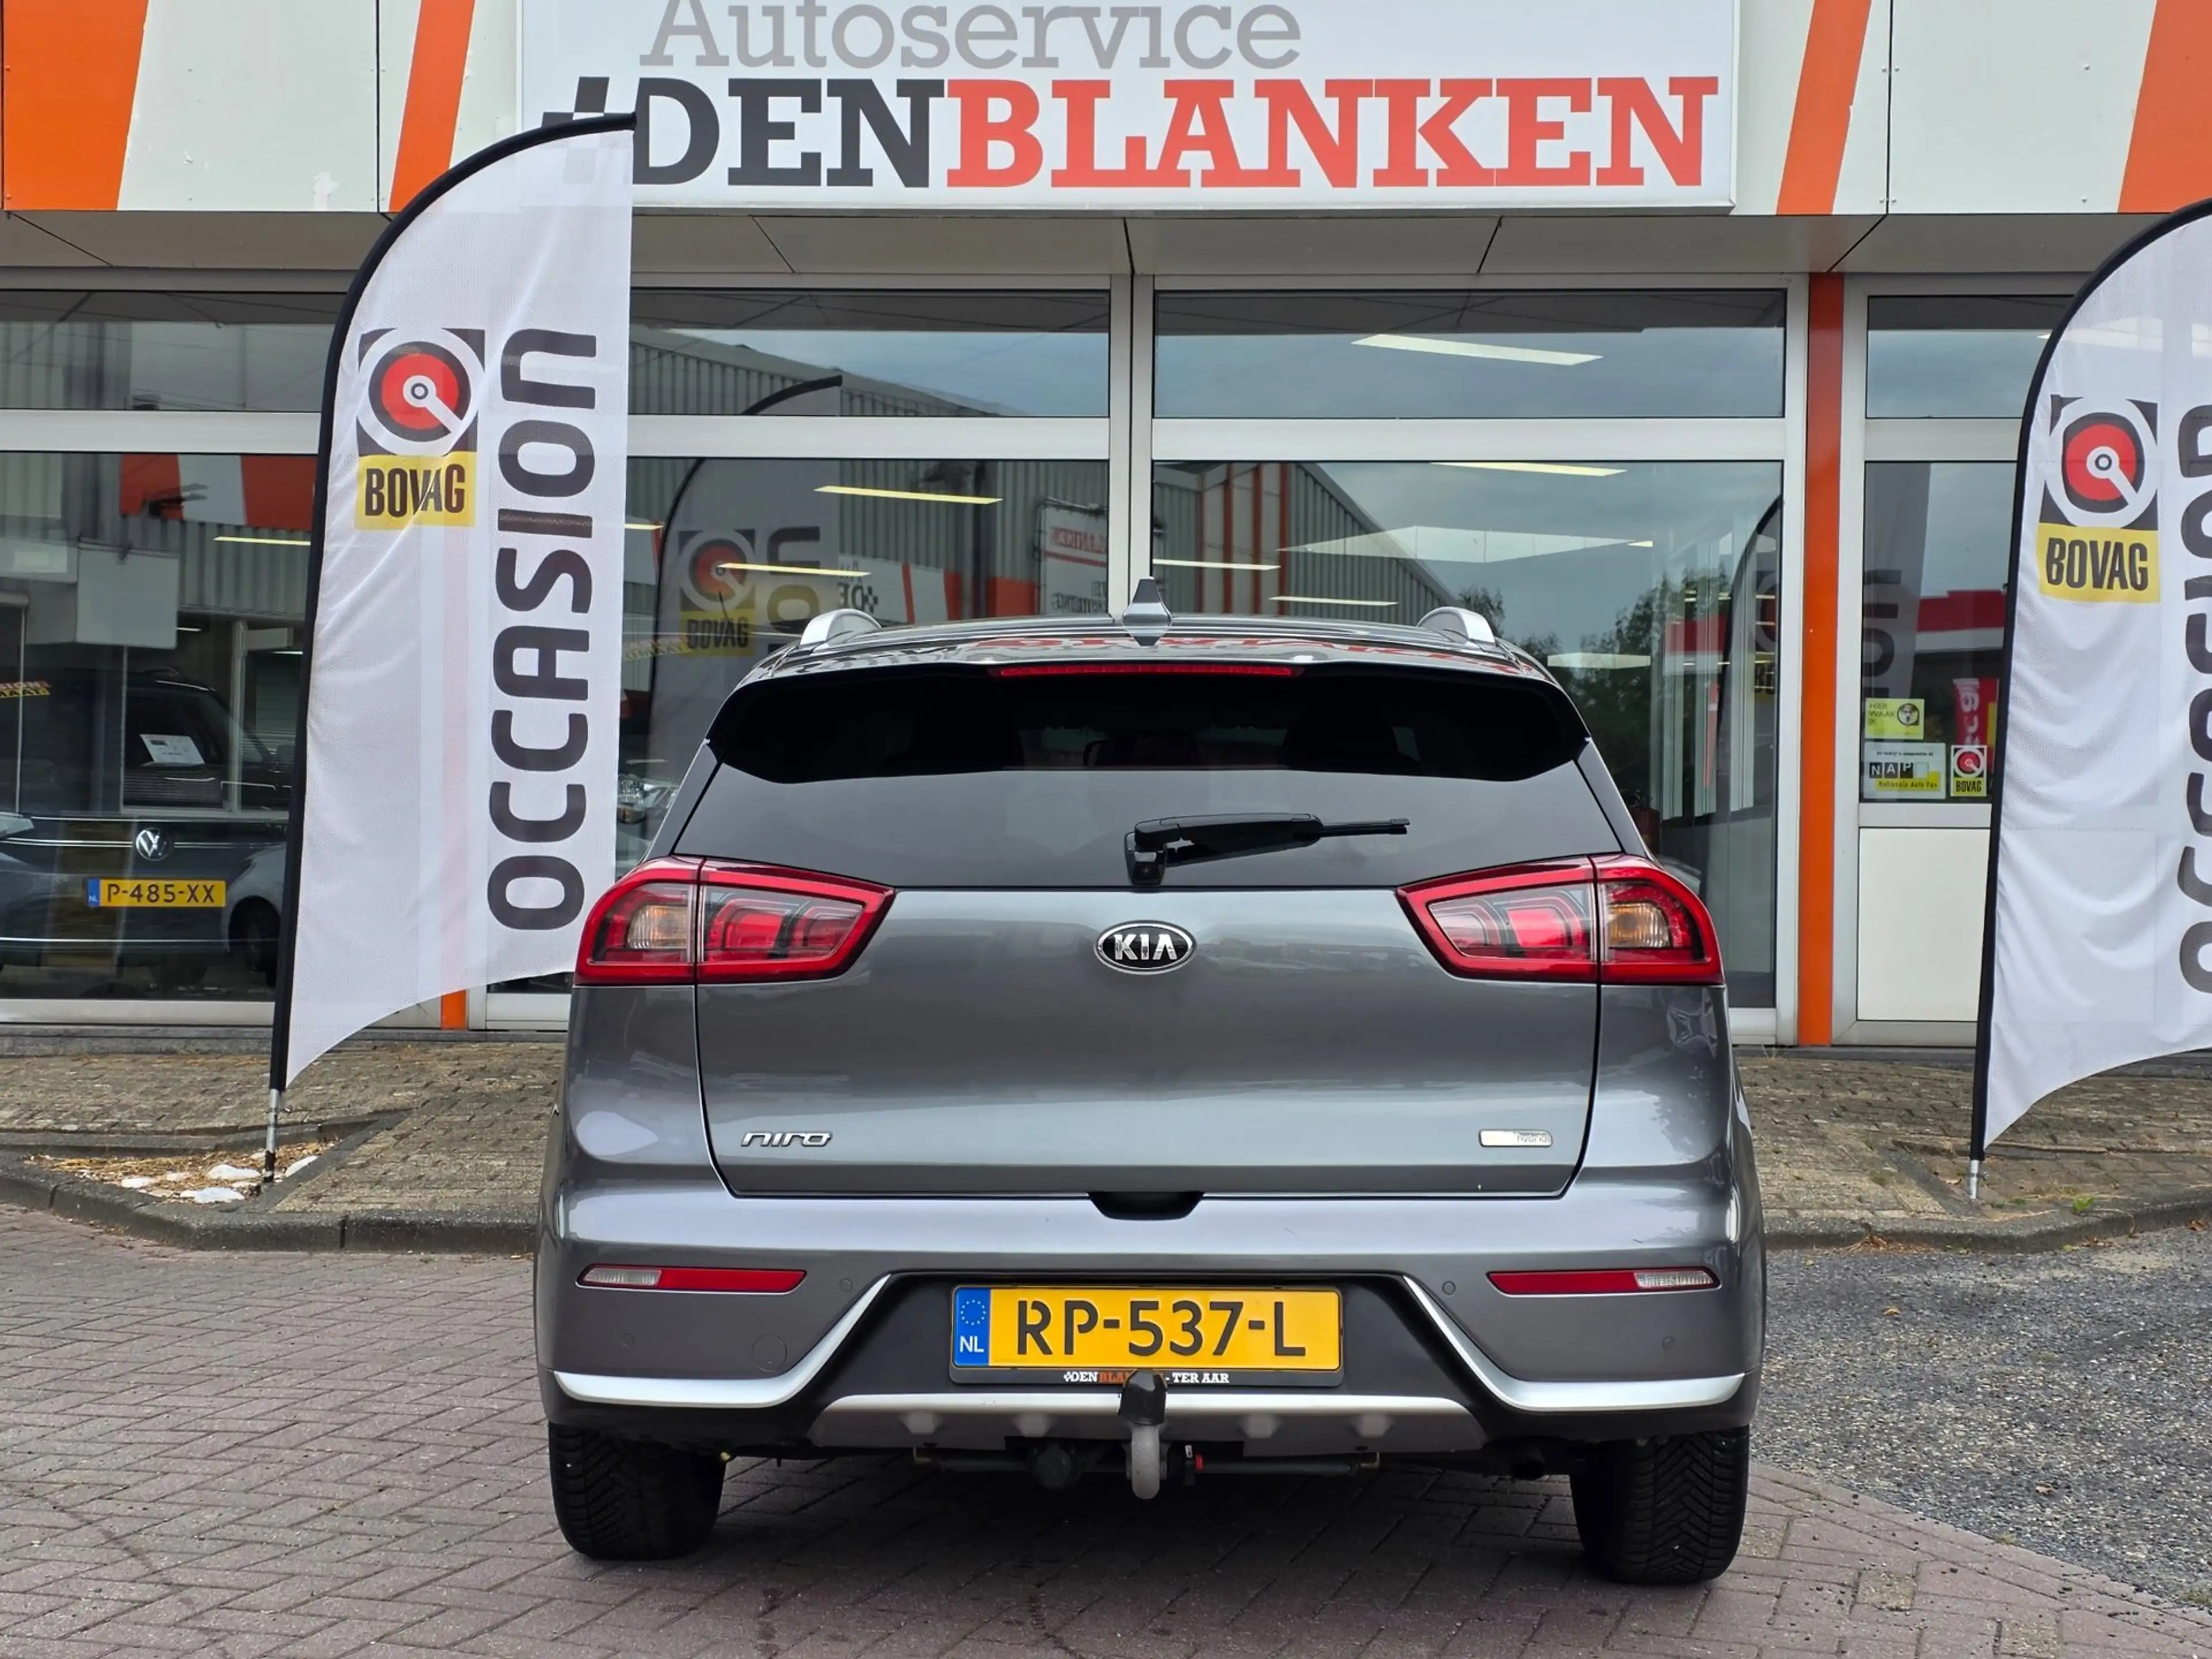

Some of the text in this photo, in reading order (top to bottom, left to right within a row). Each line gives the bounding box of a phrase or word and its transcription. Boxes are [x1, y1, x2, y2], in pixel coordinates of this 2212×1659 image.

[639, 0, 1301, 69] Autoservice
[365, 463, 465, 518] BOVAG
[2045, 537, 2149, 591] BOVAG
[487, 328, 598, 931] OCCASION
[1956, 780, 1982, 792] BOVAG
[107, 883, 215, 903] P-485-XX
[1113, 933, 1177, 960] KIA
[959, 1300, 1306, 1357] NL RP-537-L
[1172, 1372, 1200, 1383] TER
[1202, 1373, 1230, 1384] AAR
